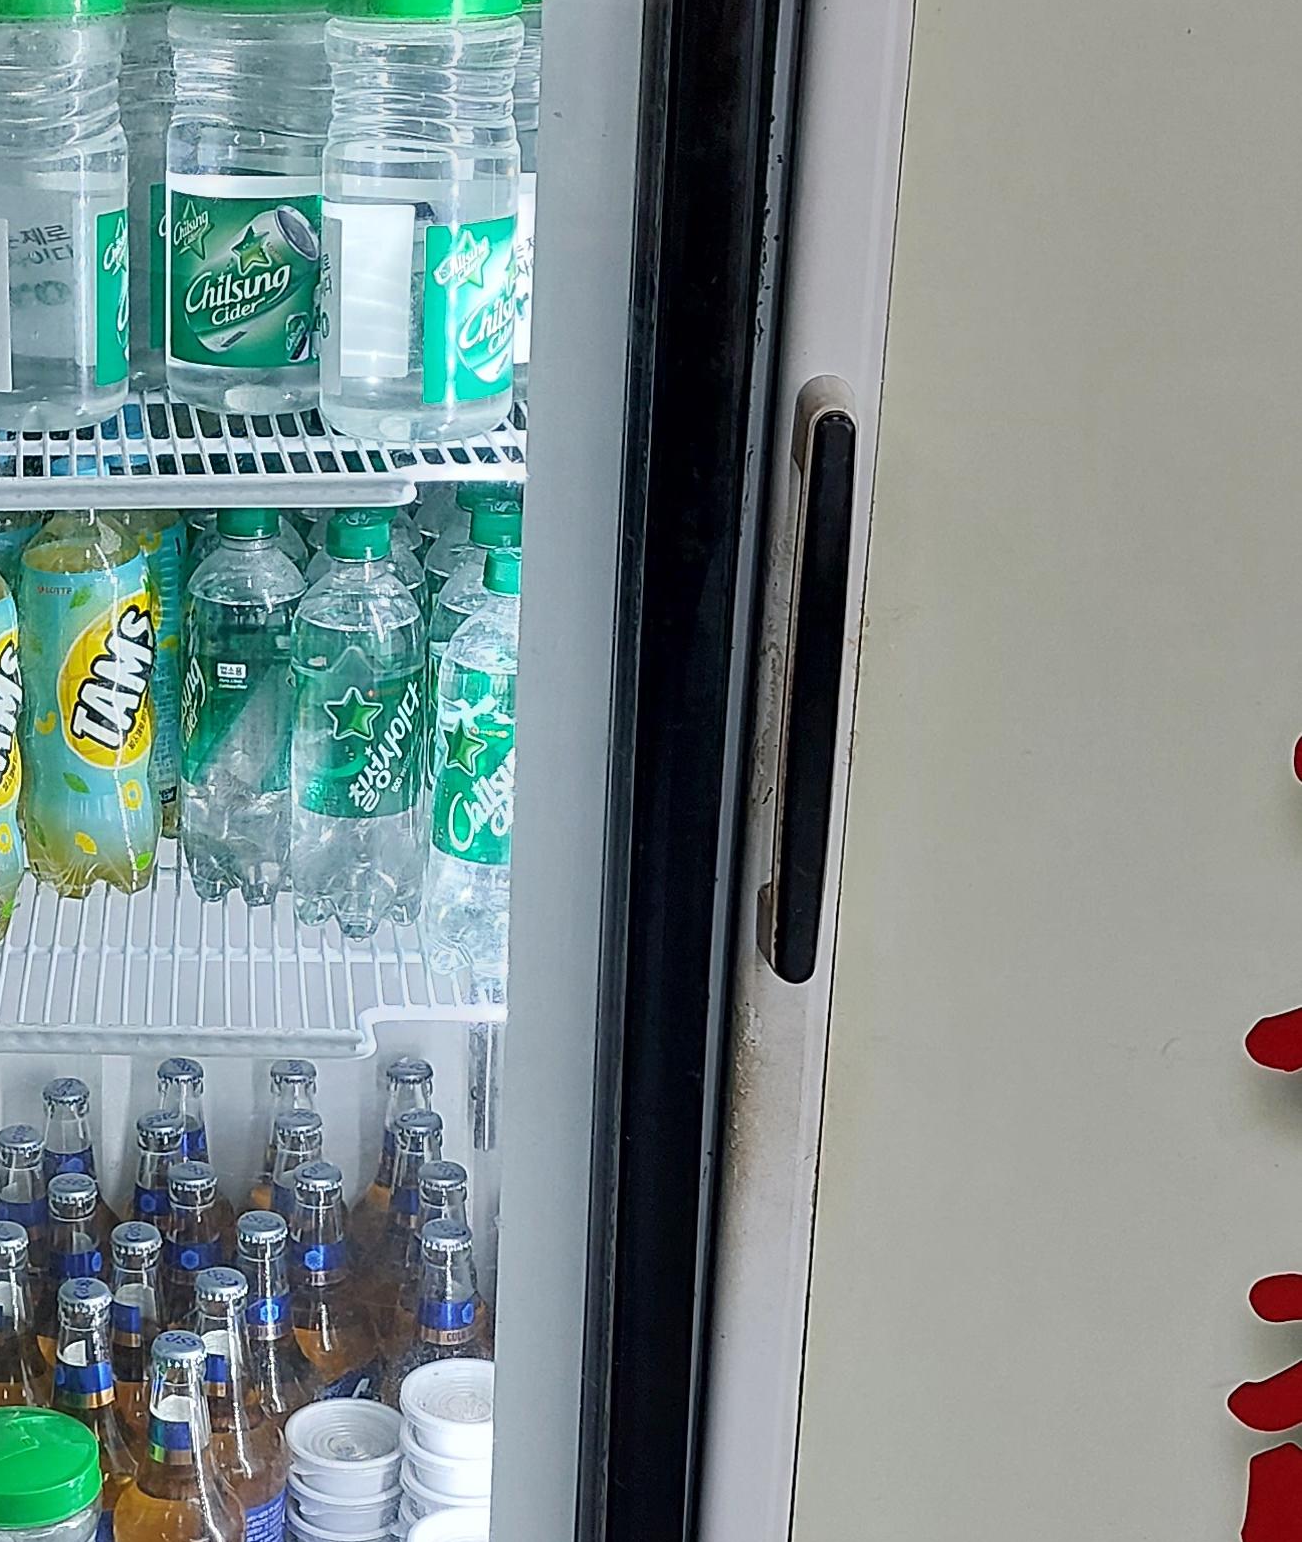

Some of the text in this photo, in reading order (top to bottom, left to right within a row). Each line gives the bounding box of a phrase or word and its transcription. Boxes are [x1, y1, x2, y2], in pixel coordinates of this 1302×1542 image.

[185, 264, 292, 314] Chilsung
[211, 296, 266, 326] Cider
[70, 604, 155, 751] TAMS
[348, 681, 420, 813] 칠성사이다
